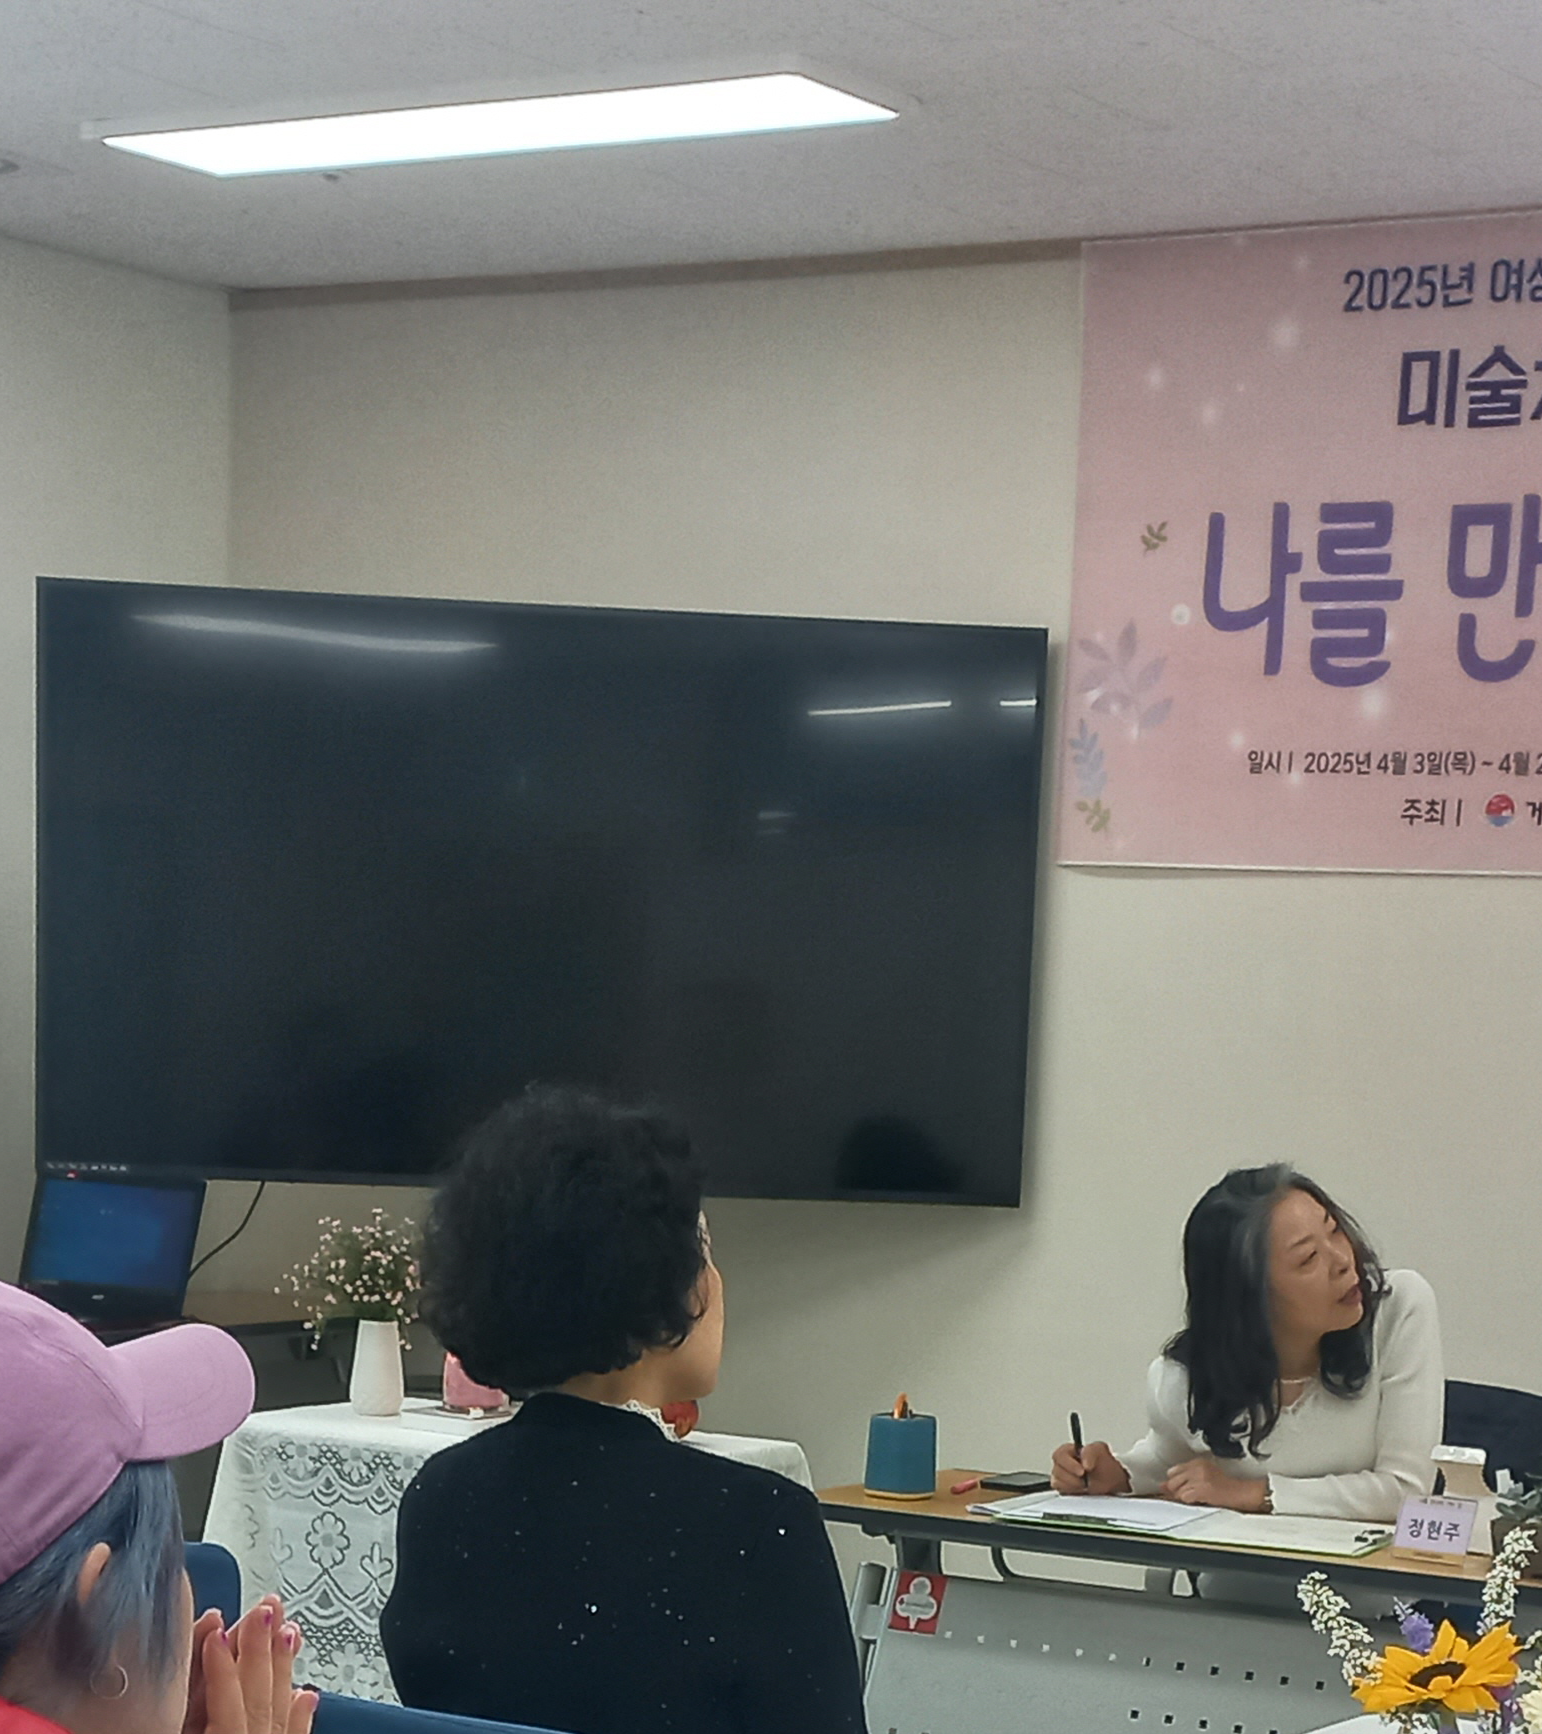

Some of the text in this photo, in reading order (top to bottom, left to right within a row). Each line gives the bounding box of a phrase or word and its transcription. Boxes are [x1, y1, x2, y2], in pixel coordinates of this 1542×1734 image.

[1343, 261, 1475, 312] 2025년
[1202, 500, 1405, 687] 나를
[1247, 750, 1282, 775] 일시
[1303, 751, 1372, 776] 2025년
[1376, 751, 1408, 776] 4월
[1412, 750, 1477, 776] 3일(목)
[1497, 751, 1530, 777] 4월
[1400, 797, 1448, 826] 주최
[1407, 1518, 1461, 1542] 정현주
